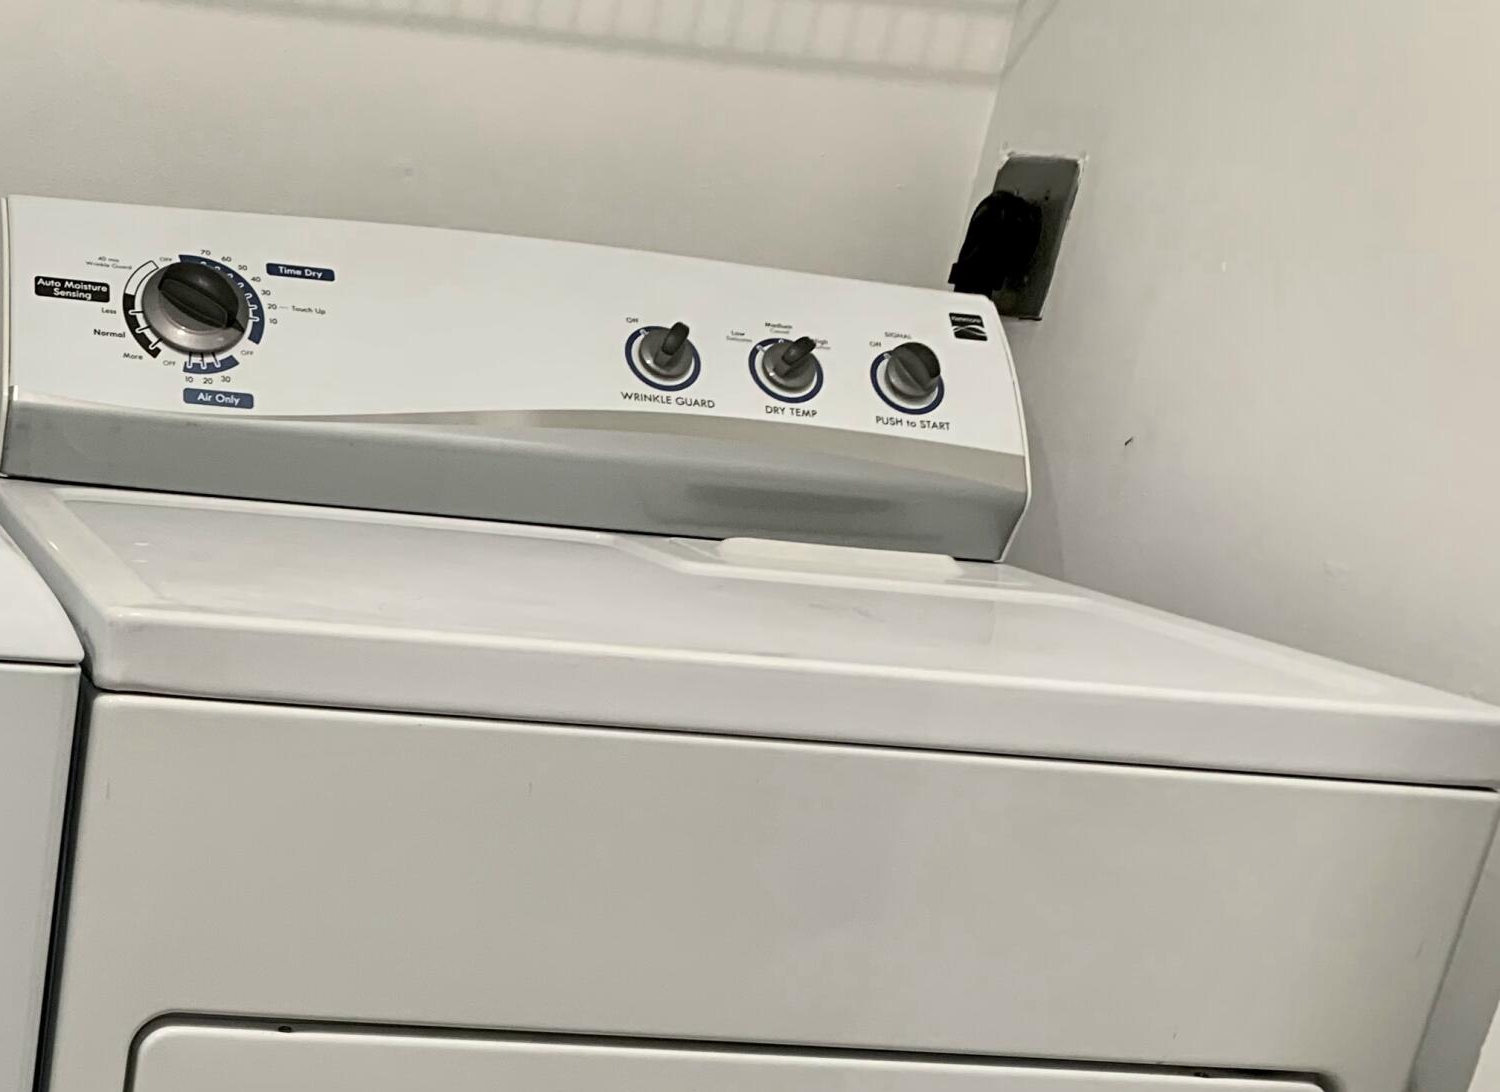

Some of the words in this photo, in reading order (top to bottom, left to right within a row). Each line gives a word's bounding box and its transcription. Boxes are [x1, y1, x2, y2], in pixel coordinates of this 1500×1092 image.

[238, 264, 248, 272] 50
[278, 265, 303, 277] Time
[304, 268, 323, 279] Dry
[37, 277, 62, 288] Auto
[64, 280, 108, 293] Moisture
[53, 287, 92, 301] Sensing
[267, 303, 278, 311] 20
[292, 305, 313, 314] Touch
[314, 307, 326, 316] Up
[93, 328, 125, 338] Normal
[123, 352, 143, 360] More
[185, 376, 194, 384] 10
[203, 377, 214, 386] 20
[221, 375, 231, 383] 30
[197, 392, 213, 402] Air
[215, 393, 241, 406] Only
[621, 391, 672, 405] WRINKLE
[675, 396, 715, 409] GUARD
[765, 405, 786, 415] DRY
[790, 407, 818, 418] TEMP
[875, 415, 903, 427] PUSH
[906, 419, 917, 428] to
[920, 420, 950, 431] START
